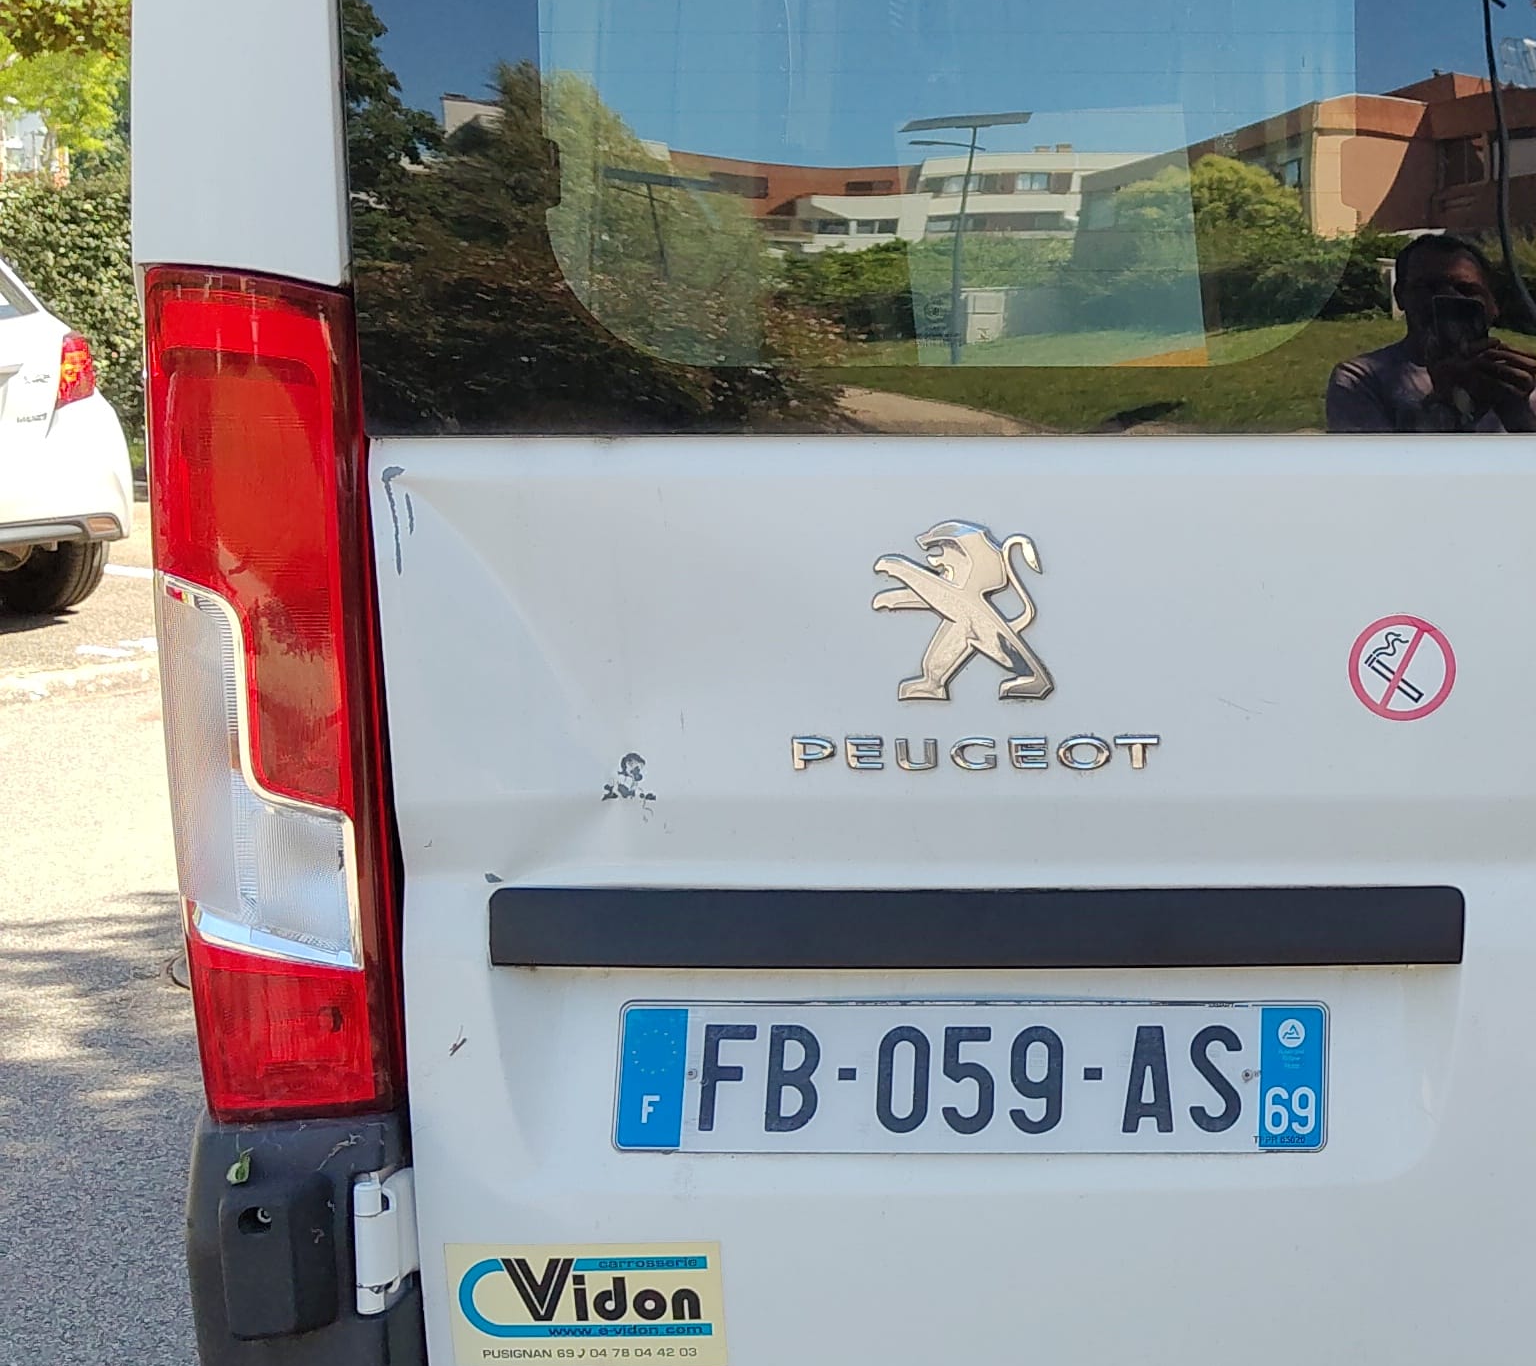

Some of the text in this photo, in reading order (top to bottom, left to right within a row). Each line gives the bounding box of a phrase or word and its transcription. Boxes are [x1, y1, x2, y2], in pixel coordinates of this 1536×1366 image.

[791, 735, 1161, 772] PEUGEOT
[640, 1094, 661, 1124] F
[698, 1023, 1243, 1135] FB-059-AS
[1264, 1086, 1317, 1135] 69
[598, 1256, 697, 1269] carrosserie
[482, 1347, 698, 1359] PUSIGNAN 69 04 78 04 42 03
